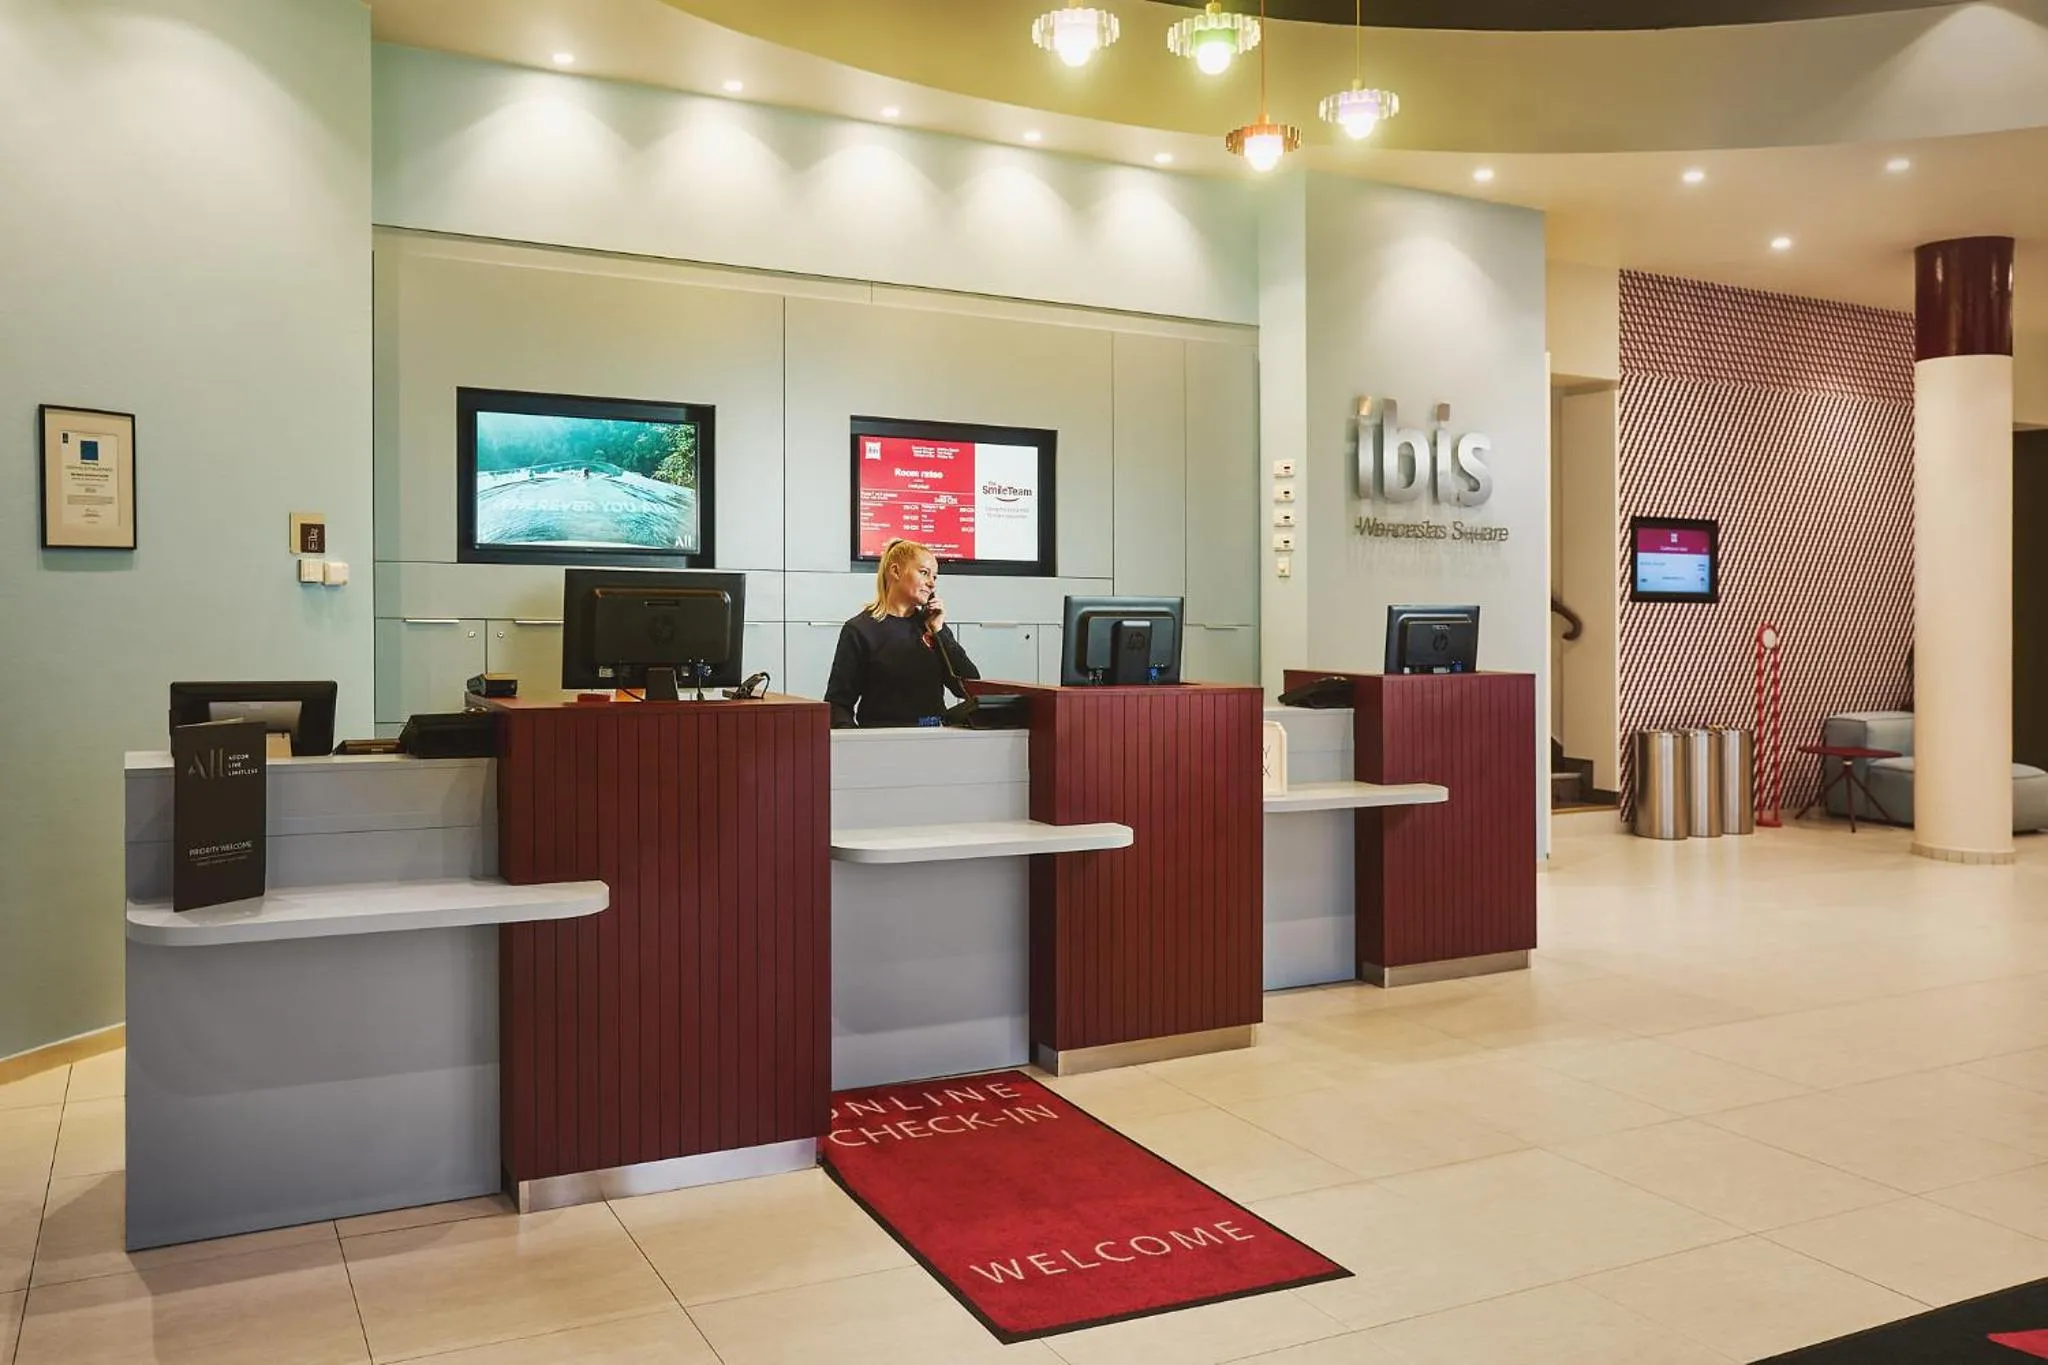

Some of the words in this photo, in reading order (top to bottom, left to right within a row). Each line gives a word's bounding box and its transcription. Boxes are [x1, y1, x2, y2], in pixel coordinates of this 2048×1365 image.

[1355, 394, 1494, 507] ibis
[894, 468, 920, 478] Room
[982, 485, 1033, 497] SmileTeam
[600, 500, 636, 514] YOU
[1451, 520, 1509, 544] Square
[830, 1082, 1021, 1121] NLINE
[828, 1103, 1059, 1147] CHECK-IN
[969, 1220, 1255, 1285] WELCOME
